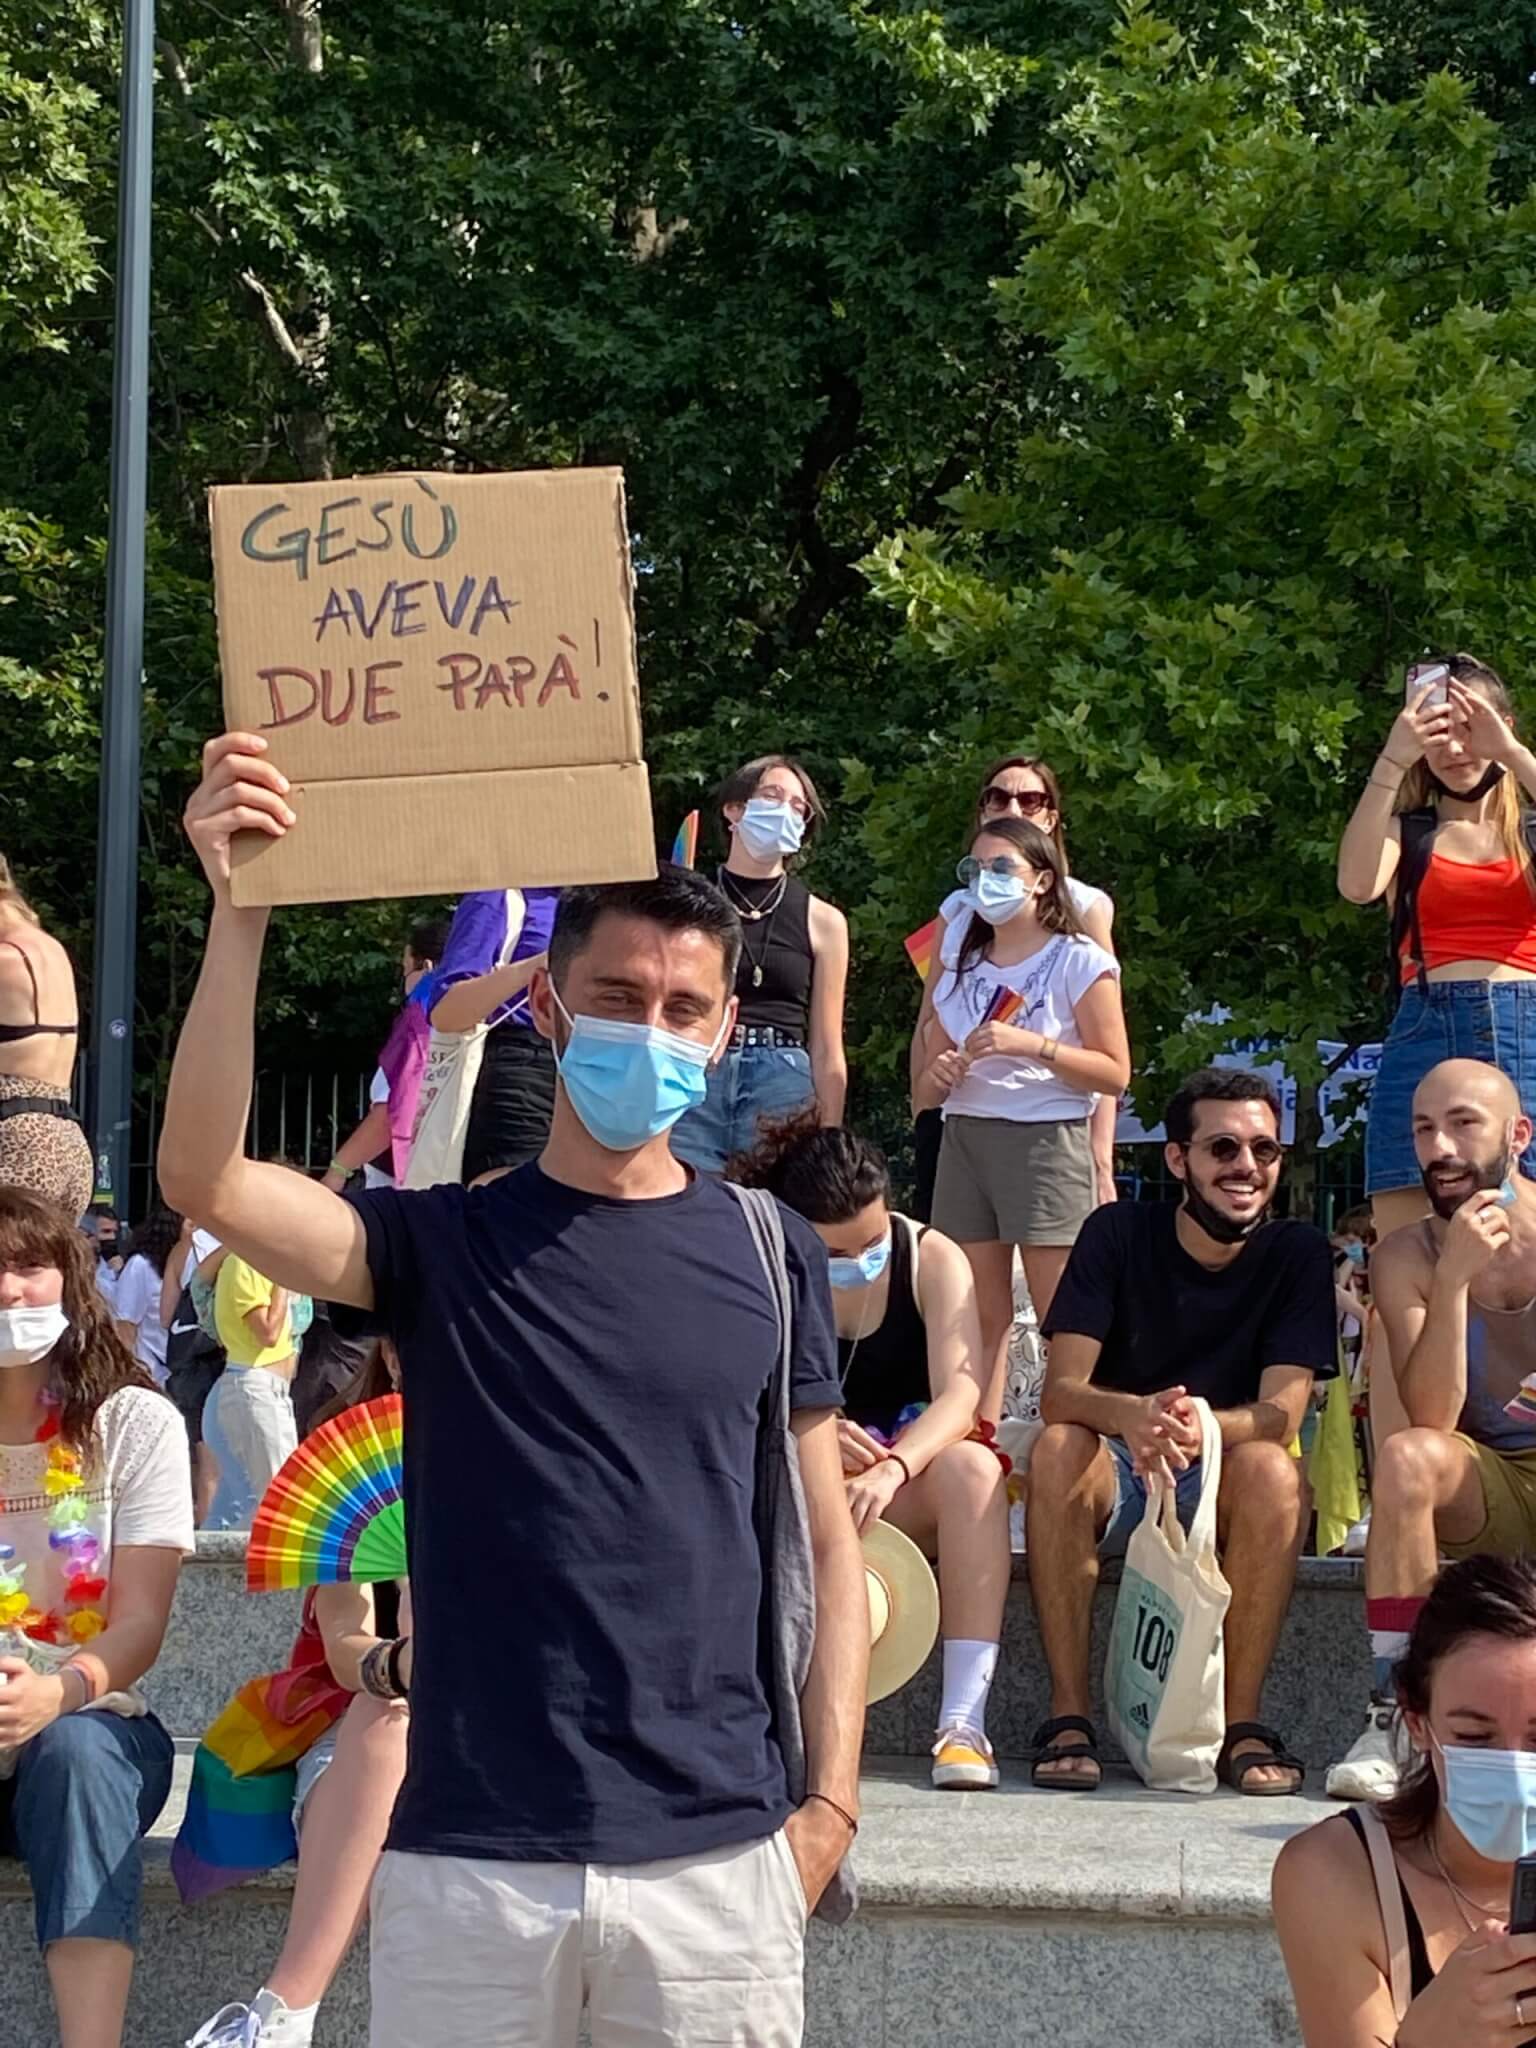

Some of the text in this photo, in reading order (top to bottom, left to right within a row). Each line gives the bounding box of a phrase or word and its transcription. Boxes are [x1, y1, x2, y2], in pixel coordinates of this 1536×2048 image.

[240, 479, 458, 580] GESÙ
[313, 575, 521, 642] AVEVA
[256, 618, 609, 730] DUE PAPÀ!
[1132, 1605, 1175, 1683] 108
